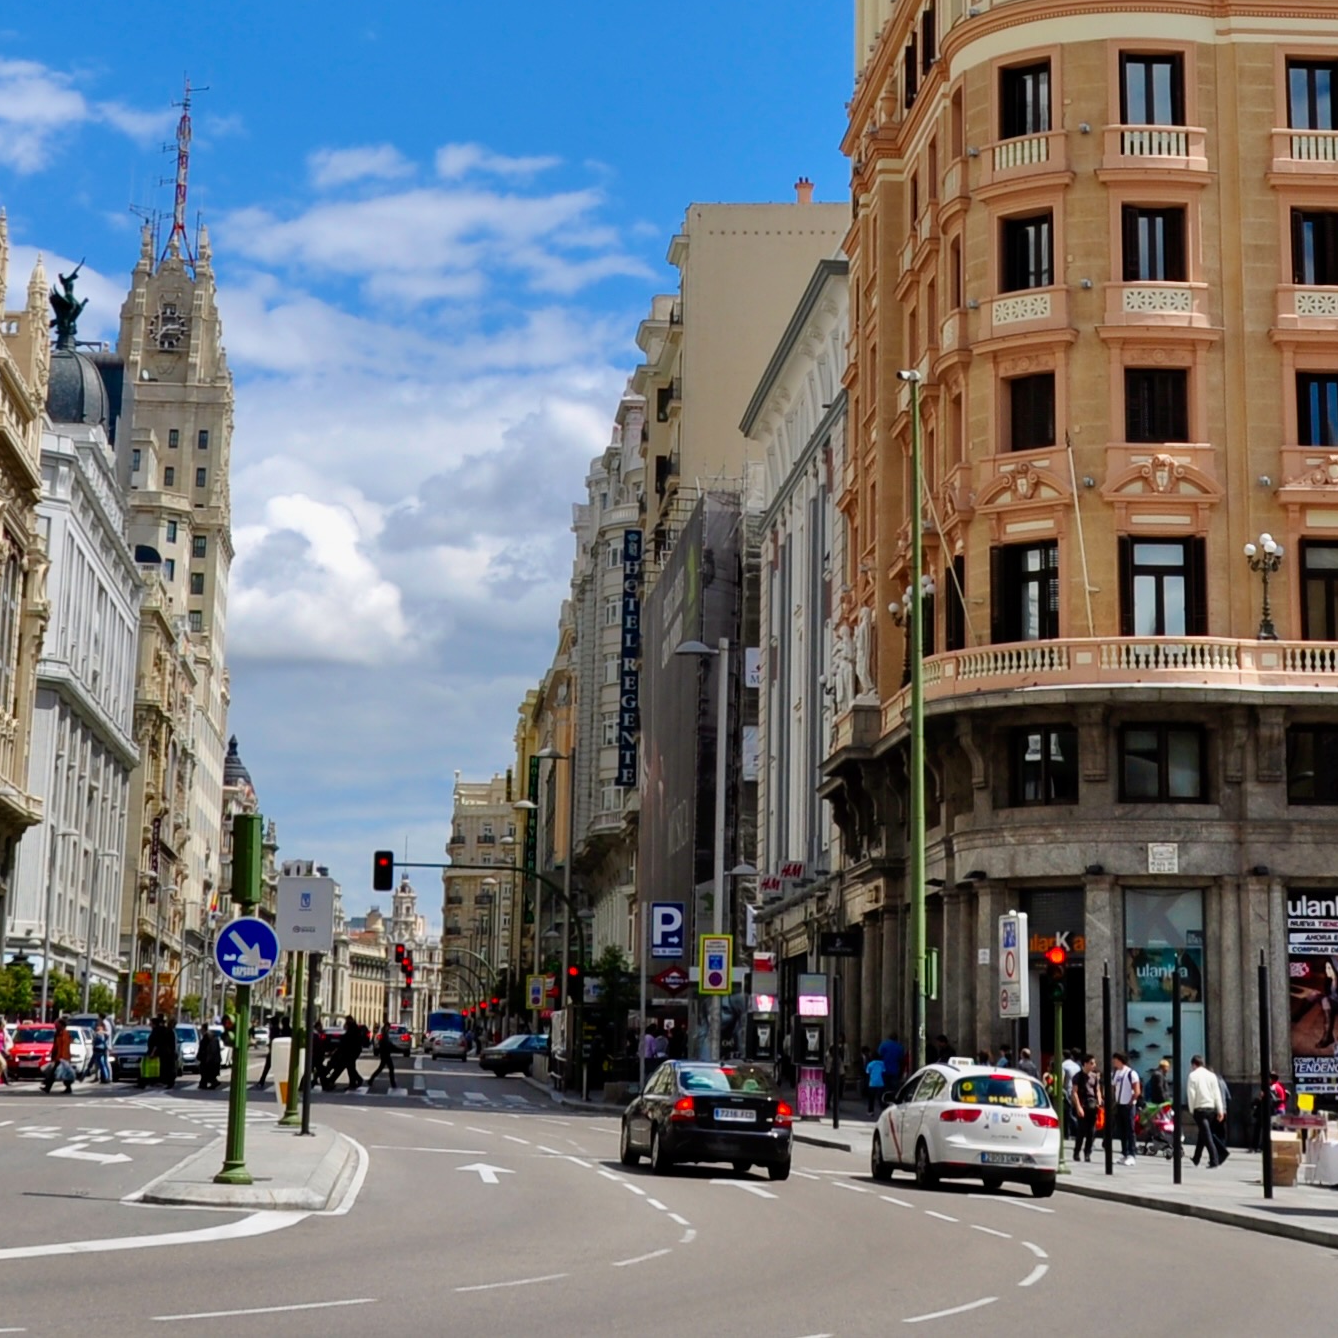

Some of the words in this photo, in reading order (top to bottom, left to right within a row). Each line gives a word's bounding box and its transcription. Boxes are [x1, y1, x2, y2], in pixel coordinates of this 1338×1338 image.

[623, 561, 640, 647] HOTEL
[620, 657, 638, 783] REGENTE
[653, 906, 682, 945] P
